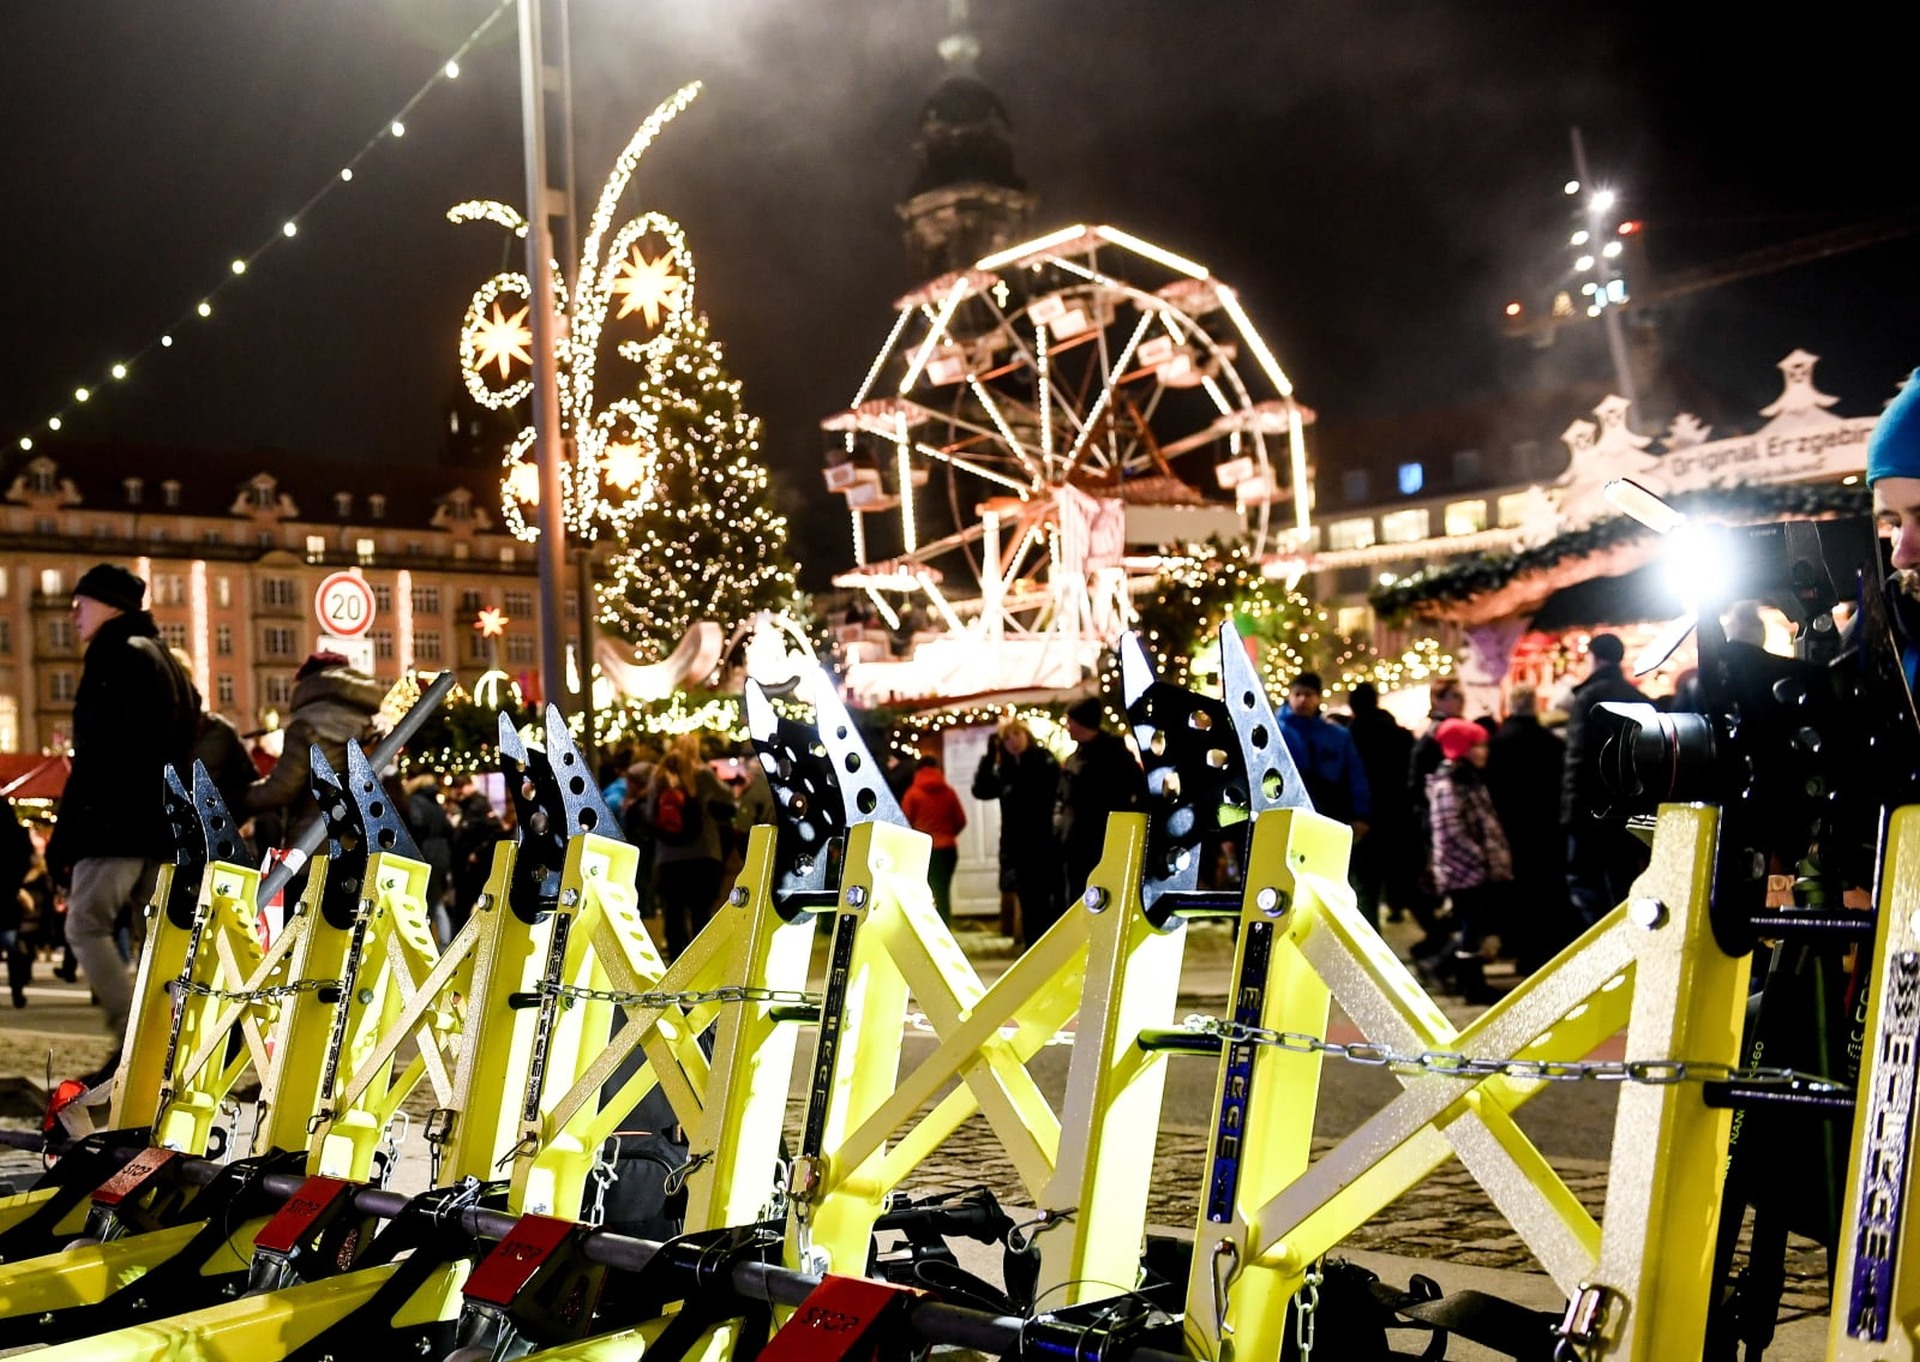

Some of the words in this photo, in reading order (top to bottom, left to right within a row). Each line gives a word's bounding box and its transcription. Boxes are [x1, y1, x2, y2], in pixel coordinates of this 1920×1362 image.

[1671, 440, 1759, 477] Original
[332, 594, 360, 620] 20
[800, 1306, 860, 1333] STOP
